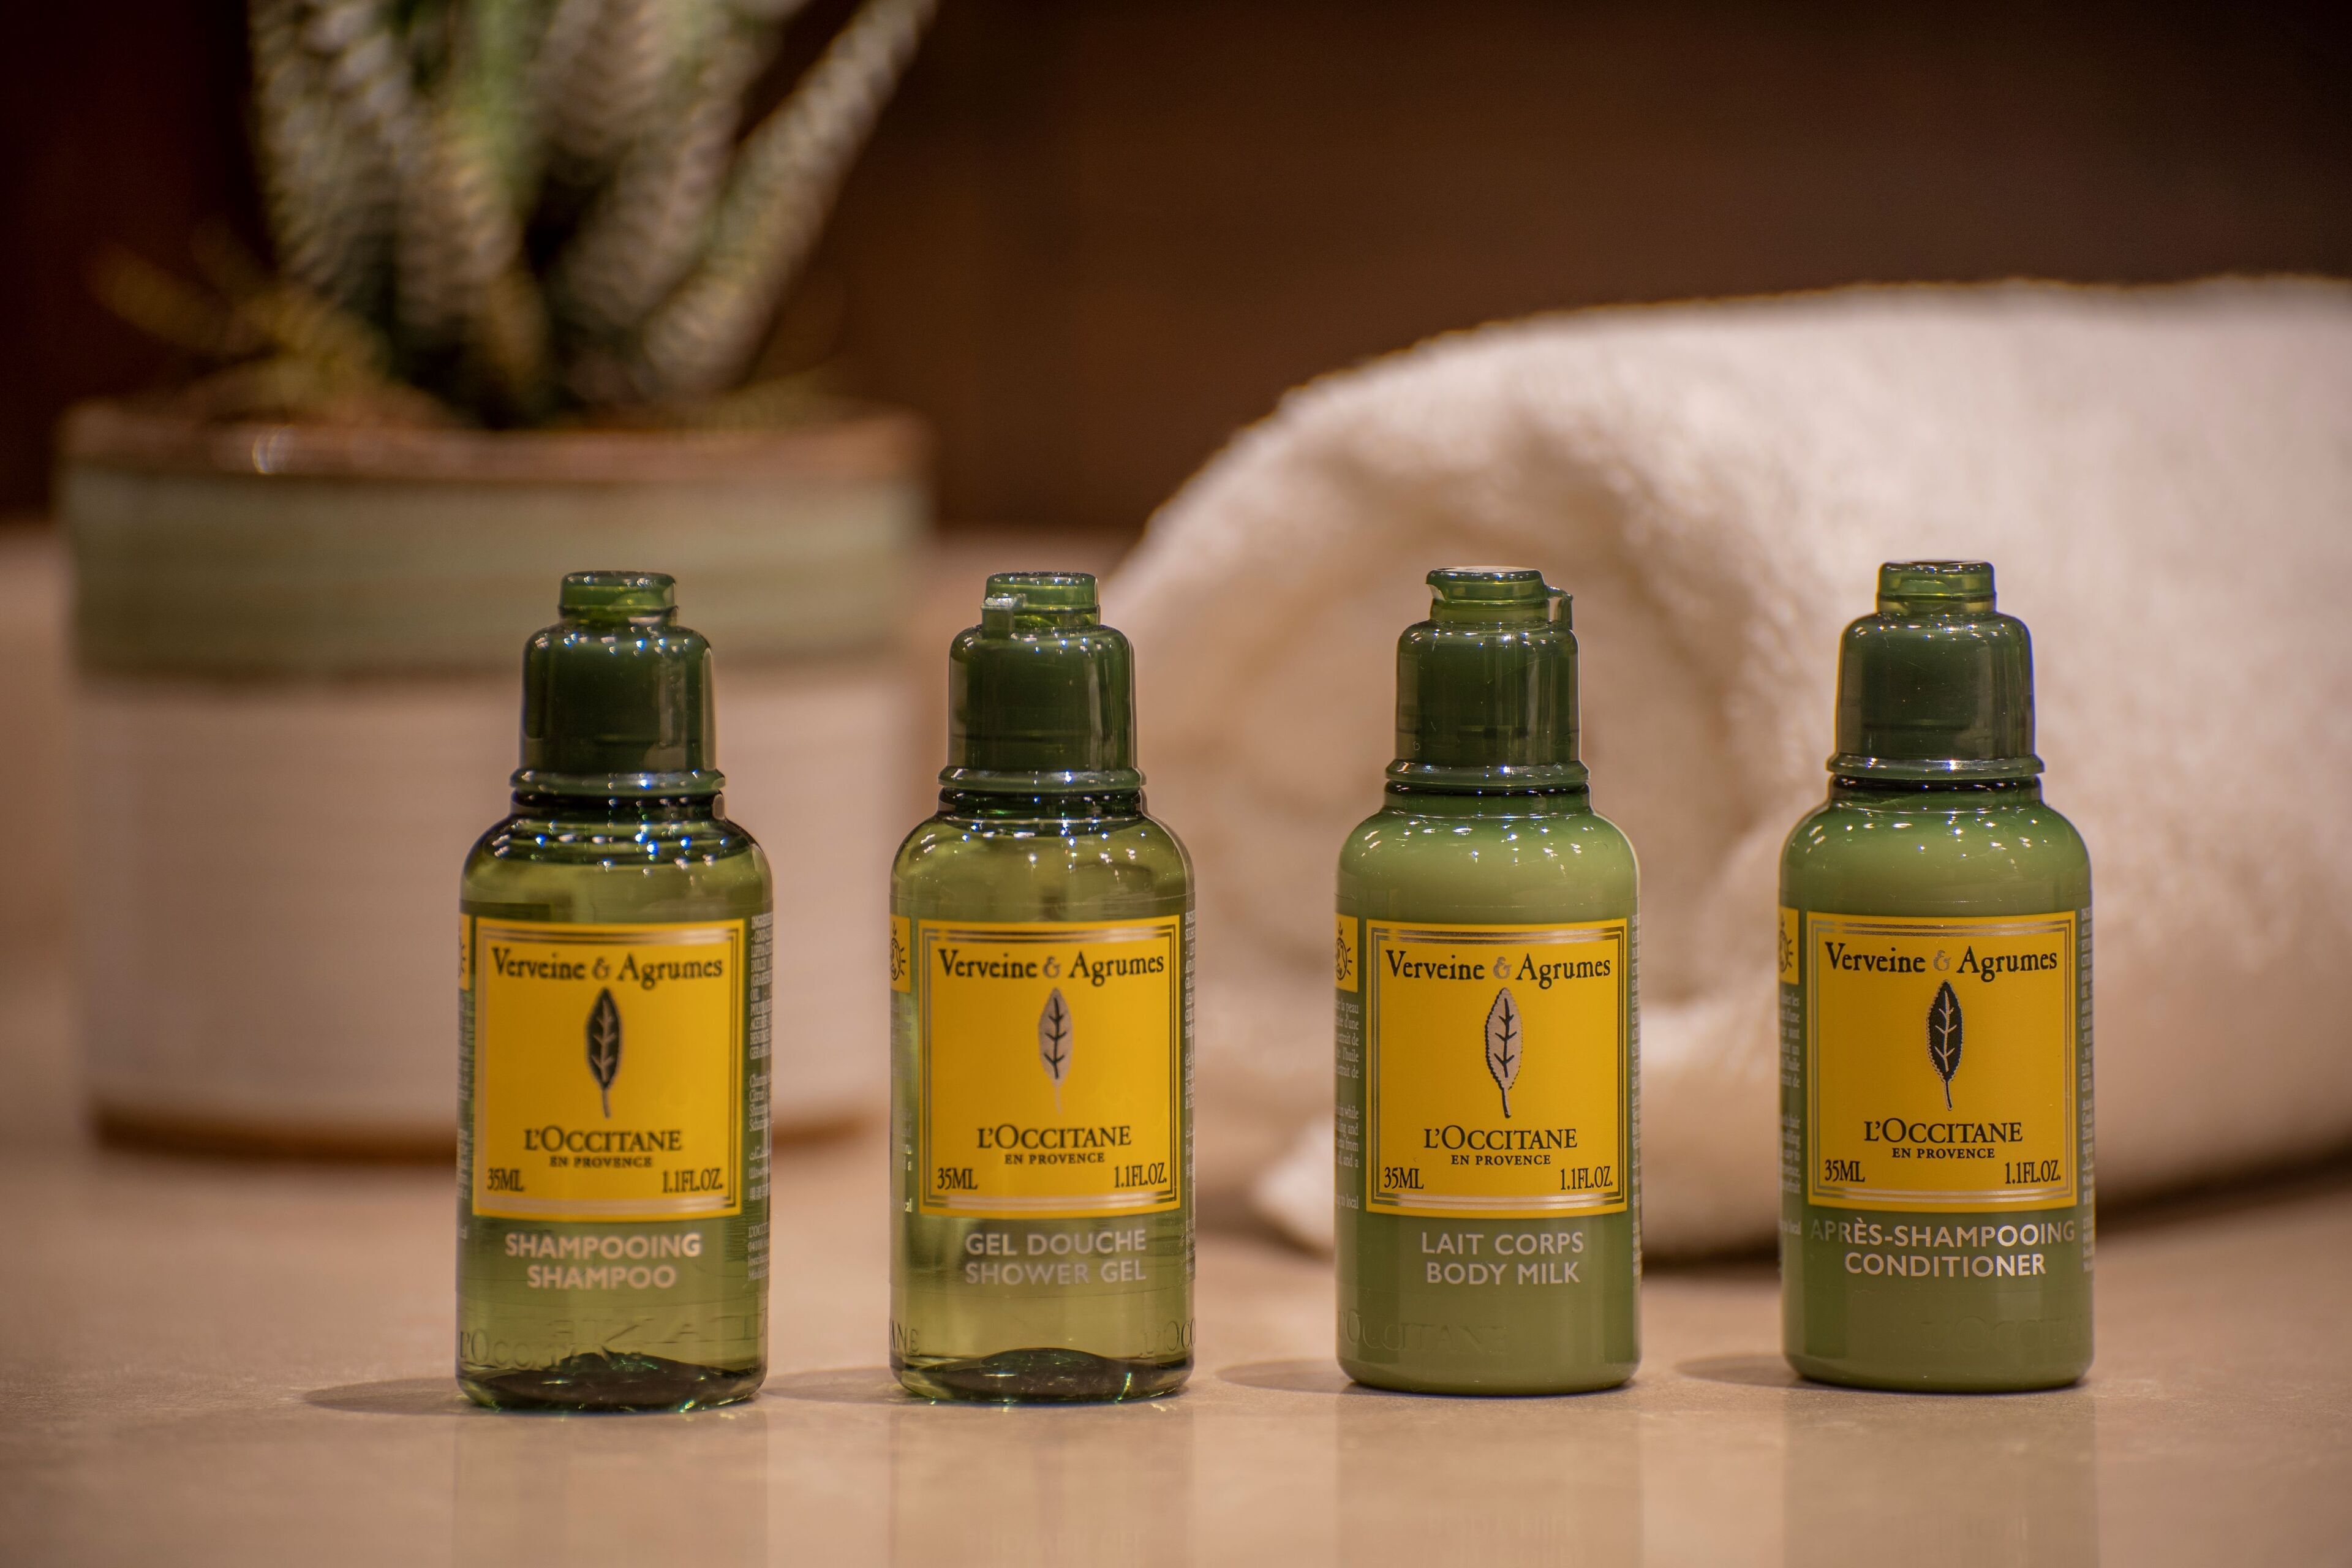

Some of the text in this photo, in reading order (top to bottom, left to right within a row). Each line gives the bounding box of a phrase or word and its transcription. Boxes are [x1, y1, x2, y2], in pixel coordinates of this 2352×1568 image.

[492, 947, 722, 990] Verveine & Agrumes
[938, 949, 1164, 987] Verveine & Agrumes
[1386, 950, 1610, 989] Verveine & Agrumes
[1825, 942, 2057, 982] Verveine & Agrumes
[750, 989, 760, 1001] OIL
[1346, 1003, 1359, 1014] peau
[1344, 1014, 1359, 1030] d'une
[1352, 1032, 1359, 1046] de
[1343, 1046, 1359, 1062] l'huile
[1351, 1065, 1359, 1079] de
[1344, 1104, 1359, 1120] while
[524, 1125, 680, 1152] L'OCCITANE
[977, 1124, 1131, 1149] L'OCCITANE
[1348, 1123, 1358, 1136] and
[1424, 1125, 1577, 1150] L'OCCITANE
[1864, 1118, 2022, 1143] L'OCCITANE
[1346, 1137, 1359, 1152] from
[1893, 1148, 1994, 1158] EN PROVENCE
[550, 1156, 651, 1167] EN PROVENCE
[1005, 1153, 1104, 1164] EN PROVENCE
[1344, 1154, 1352, 1167] and
[1355, 1158, 1359, 1168] a
[1452, 1155, 1550, 1165] EN PROVENCE
[488, 1168, 524, 1192] 35ML
[938, 1167, 978, 1189] 35ML
[1384, 1167, 1423, 1189] 35ML
[1825, 1159, 1865, 1182] 35ML
[1346, 1194, 1359, 1210] local
[965, 1231, 1145, 1256] GEL DOUCHE
[1422, 1232, 1584, 1254] LAIT CORPS
[1811, 1217, 2075, 1248] APRÈS-SHAMPOOING
[505, 1234, 702, 1259] SHAMPOOING
[965, 1260, 1146, 1285] SHOWER GEL
[1428, 1262, 1580, 1285] BODY MILK
[1845, 1252, 2046, 1276] CONDITIONER
[527, 1265, 676, 1289] SHAMPOO
